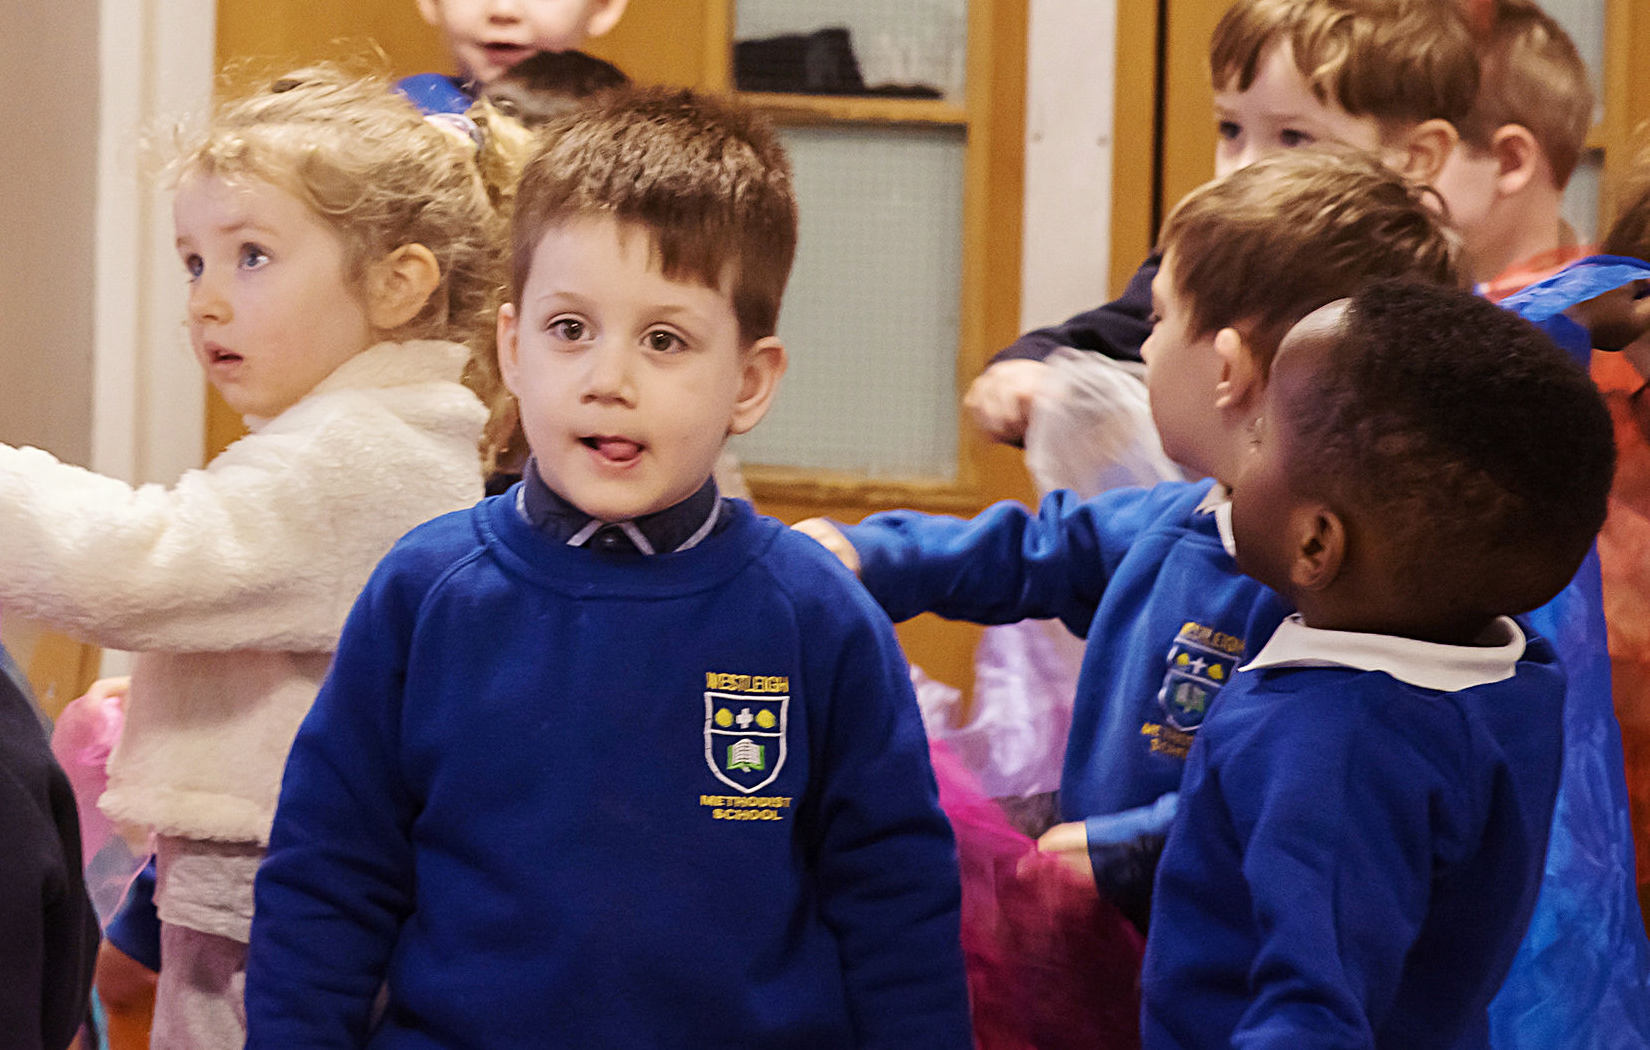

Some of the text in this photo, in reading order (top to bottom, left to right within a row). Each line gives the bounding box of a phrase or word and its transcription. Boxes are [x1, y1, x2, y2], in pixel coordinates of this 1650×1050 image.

[705, 672, 790, 693] WESTLEIGH
[700, 794, 793, 808] METHODIST
[712, 808, 783, 821] SCHOOL
